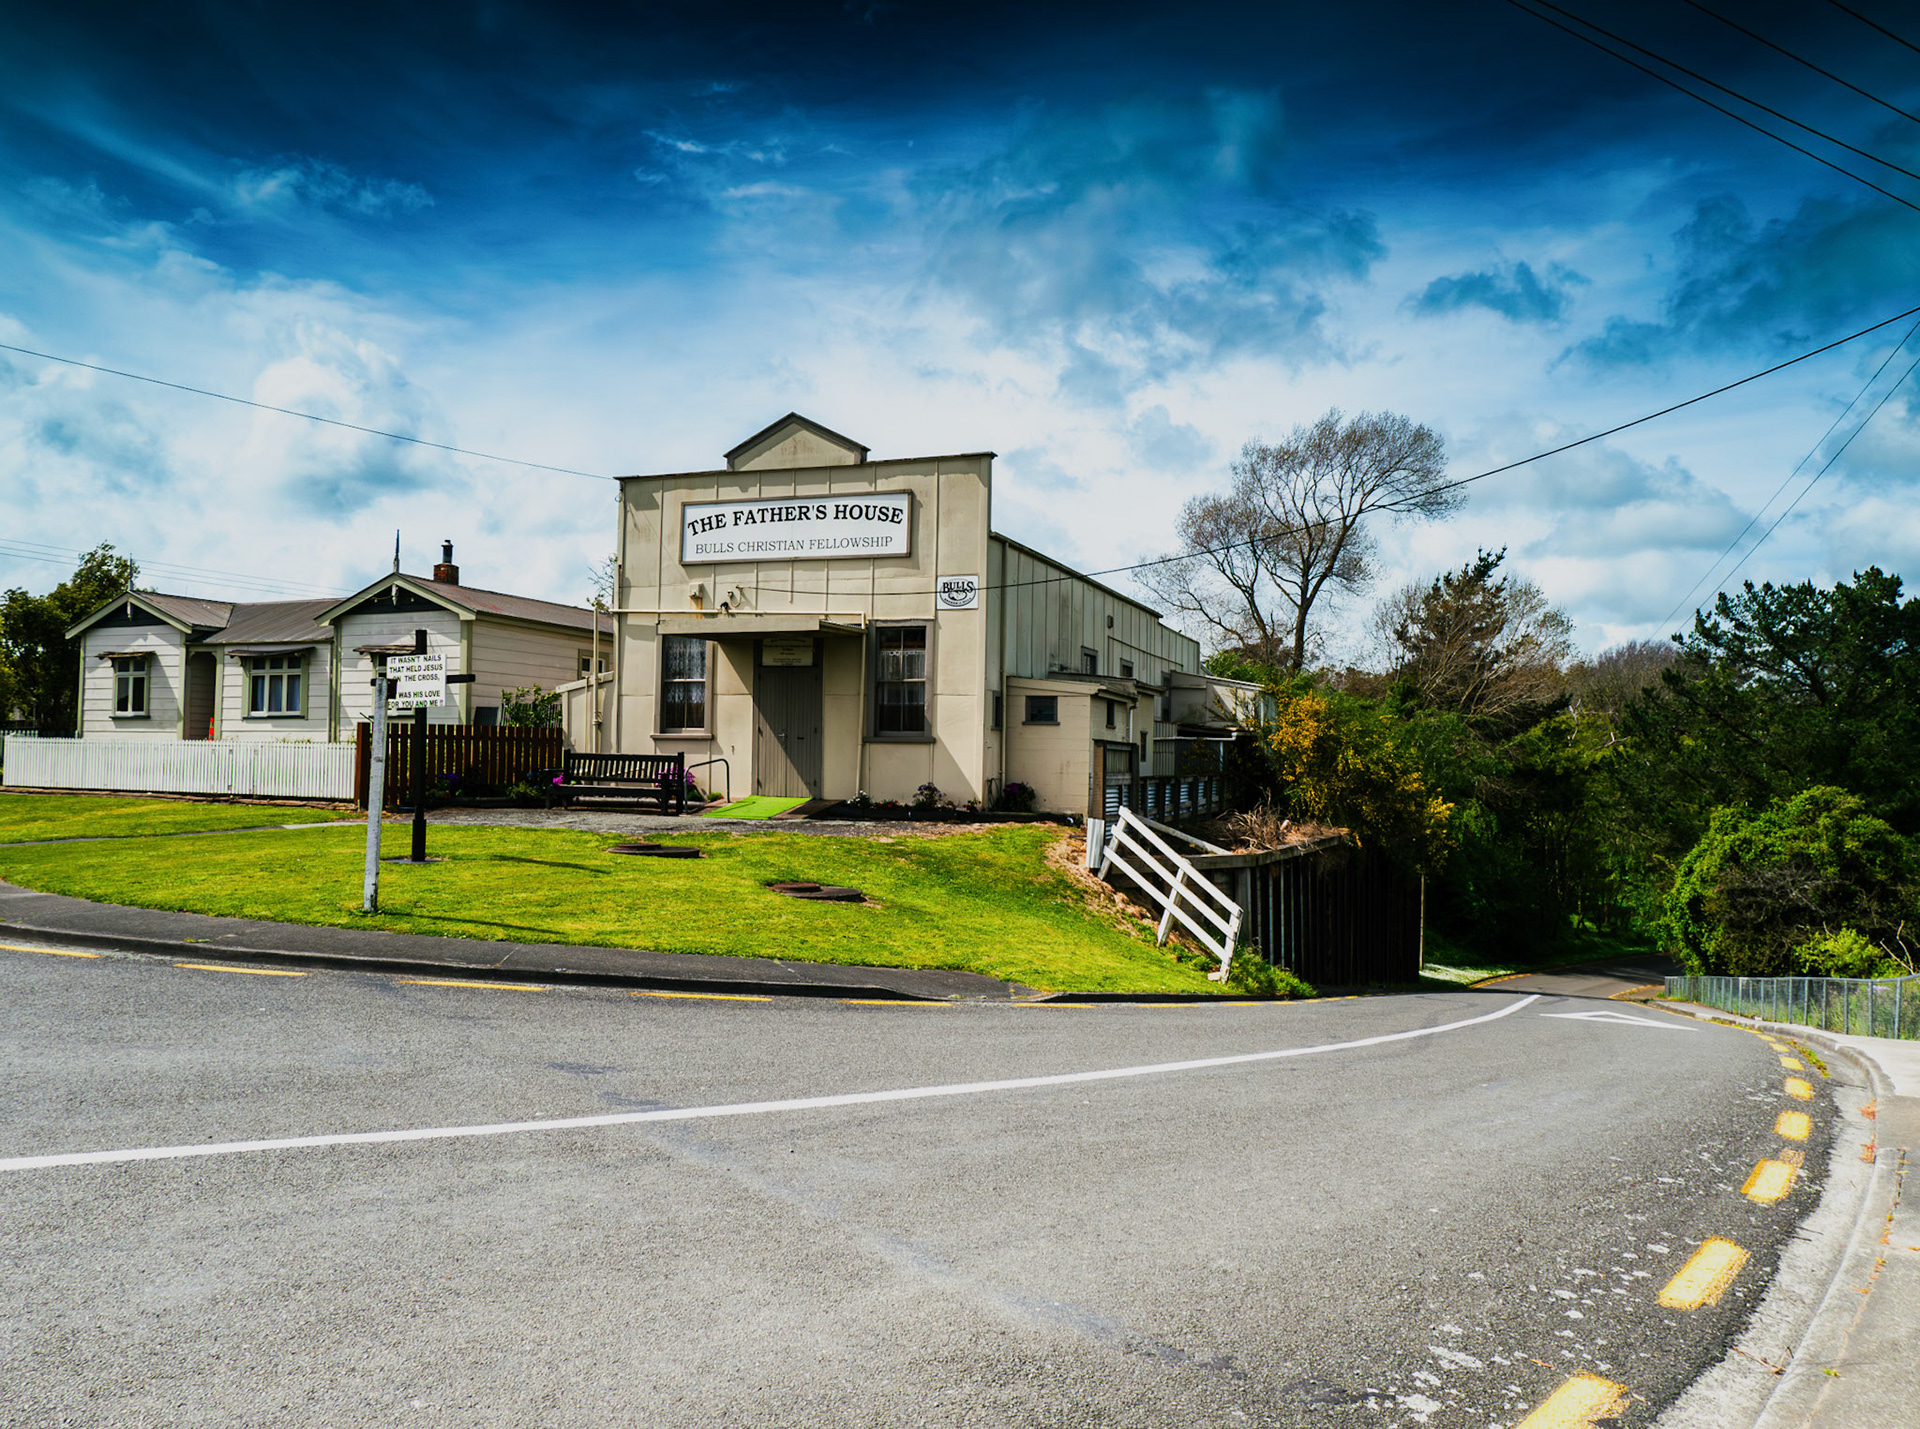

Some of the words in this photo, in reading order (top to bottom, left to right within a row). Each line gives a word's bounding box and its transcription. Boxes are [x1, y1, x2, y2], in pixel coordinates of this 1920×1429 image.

[687, 513, 727, 536] THE
[732, 504, 827, 526] FATHER'S
[833, 504, 904, 525] HOUSE
[695, 542, 734, 554] BULLS
[737, 540, 805, 553] CHRISTIAN
[809, 536, 893, 550] FELLOWSHIP
[942, 581, 974, 593] BULLS
[424, 690, 440, 698] LOVE
